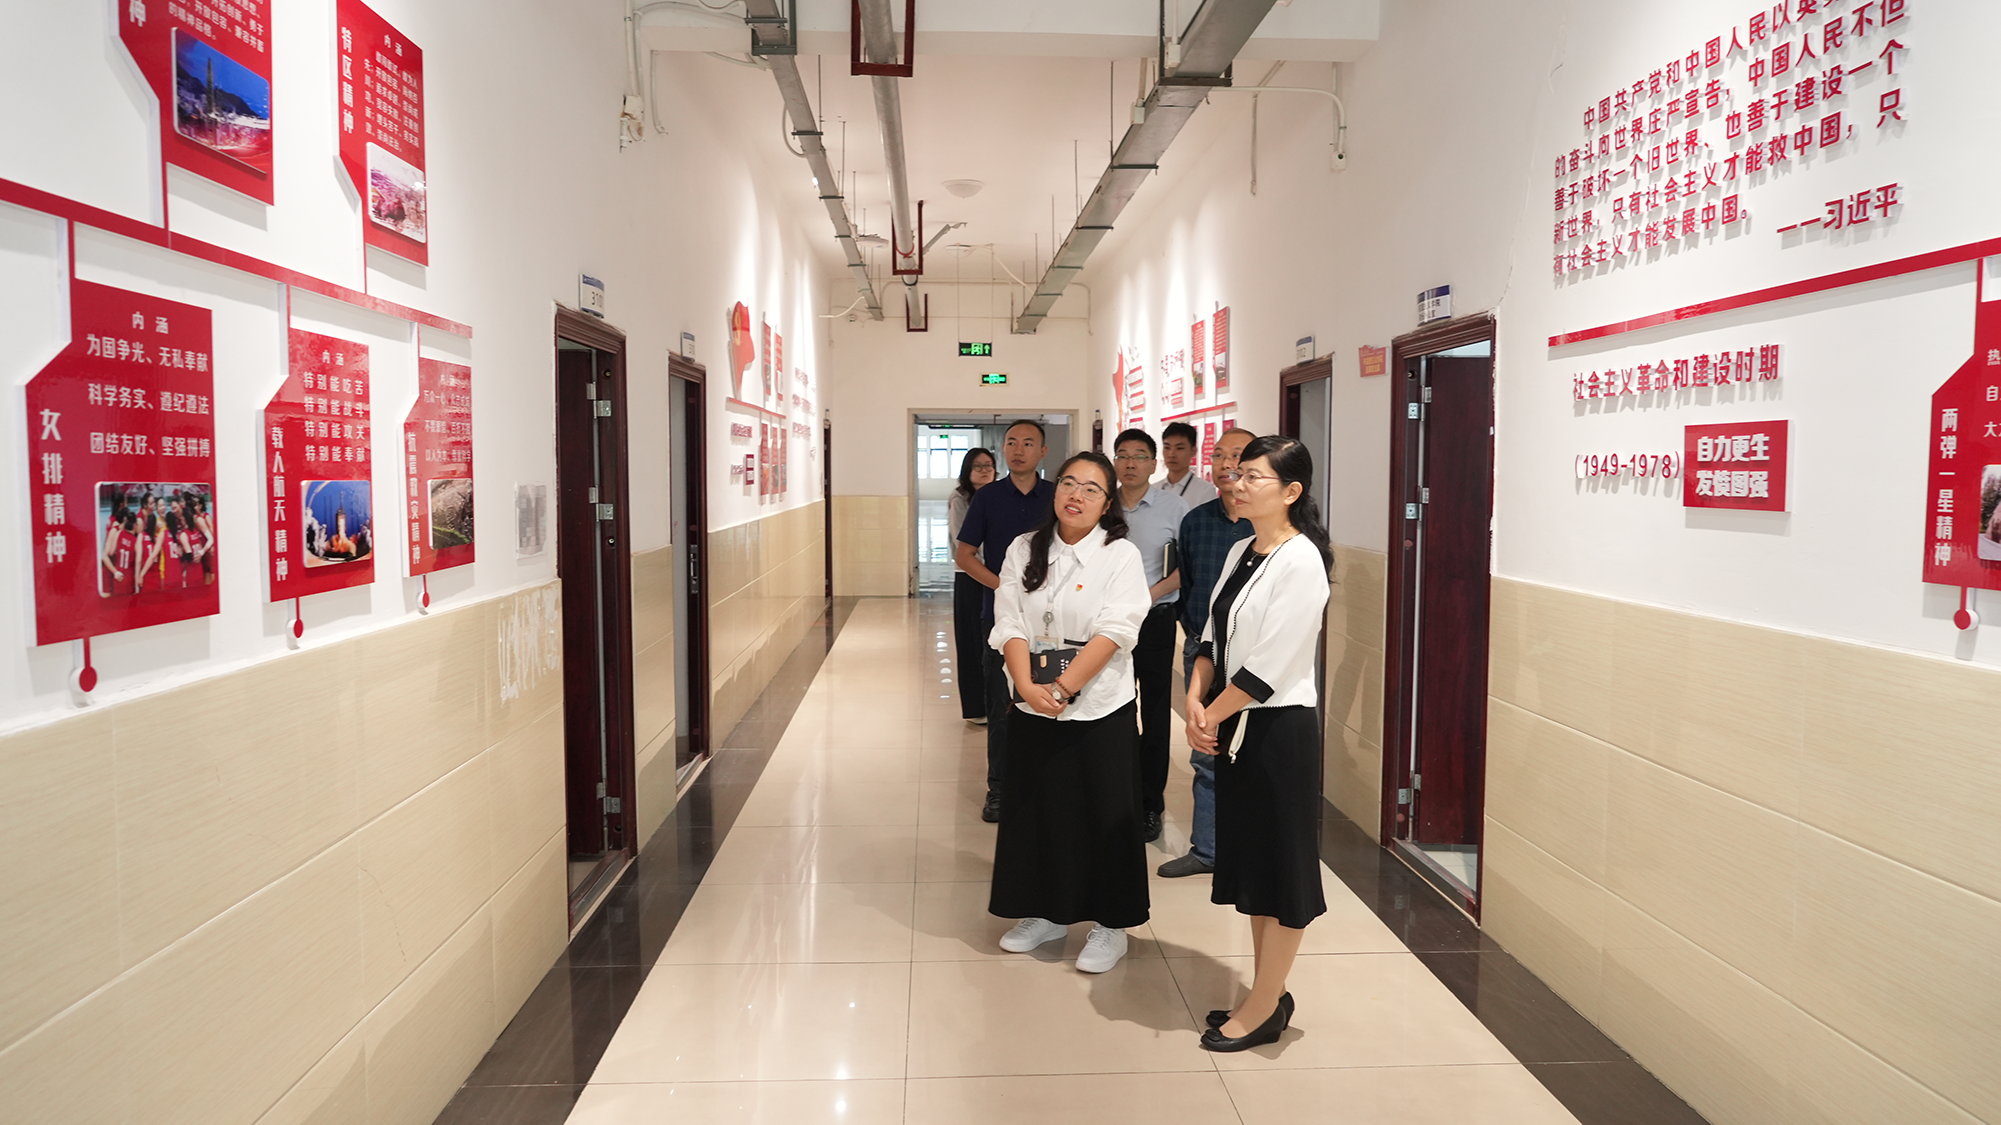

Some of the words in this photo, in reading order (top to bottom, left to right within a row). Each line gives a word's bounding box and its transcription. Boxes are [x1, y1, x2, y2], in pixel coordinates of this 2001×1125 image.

[1584, 0, 1842, 130] 中国共产党和中国人民以英
[1553, 194, 1747, 277] 有社会主义才能发展中国。
[132, 311, 169, 334] 内涵
[87, 333, 209, 372] 为国争光、无私奉献
[1573, 344, 1780, 401] 社会主义革命和建设时期
[303, 371, 364, 396] 特别能吃苦
[90, 432, 211, 457] 团结友好、坚强拼搏
[1697, 433, 1770, 462] 自力更生
[39, 408, 67, 564] 女排精神
[271, 426, 288, 581] 载人航天精神
[1695, 470, 1769, 498] 发愤图强
[1934, 408, 1959, 566] 两弹一星精神
